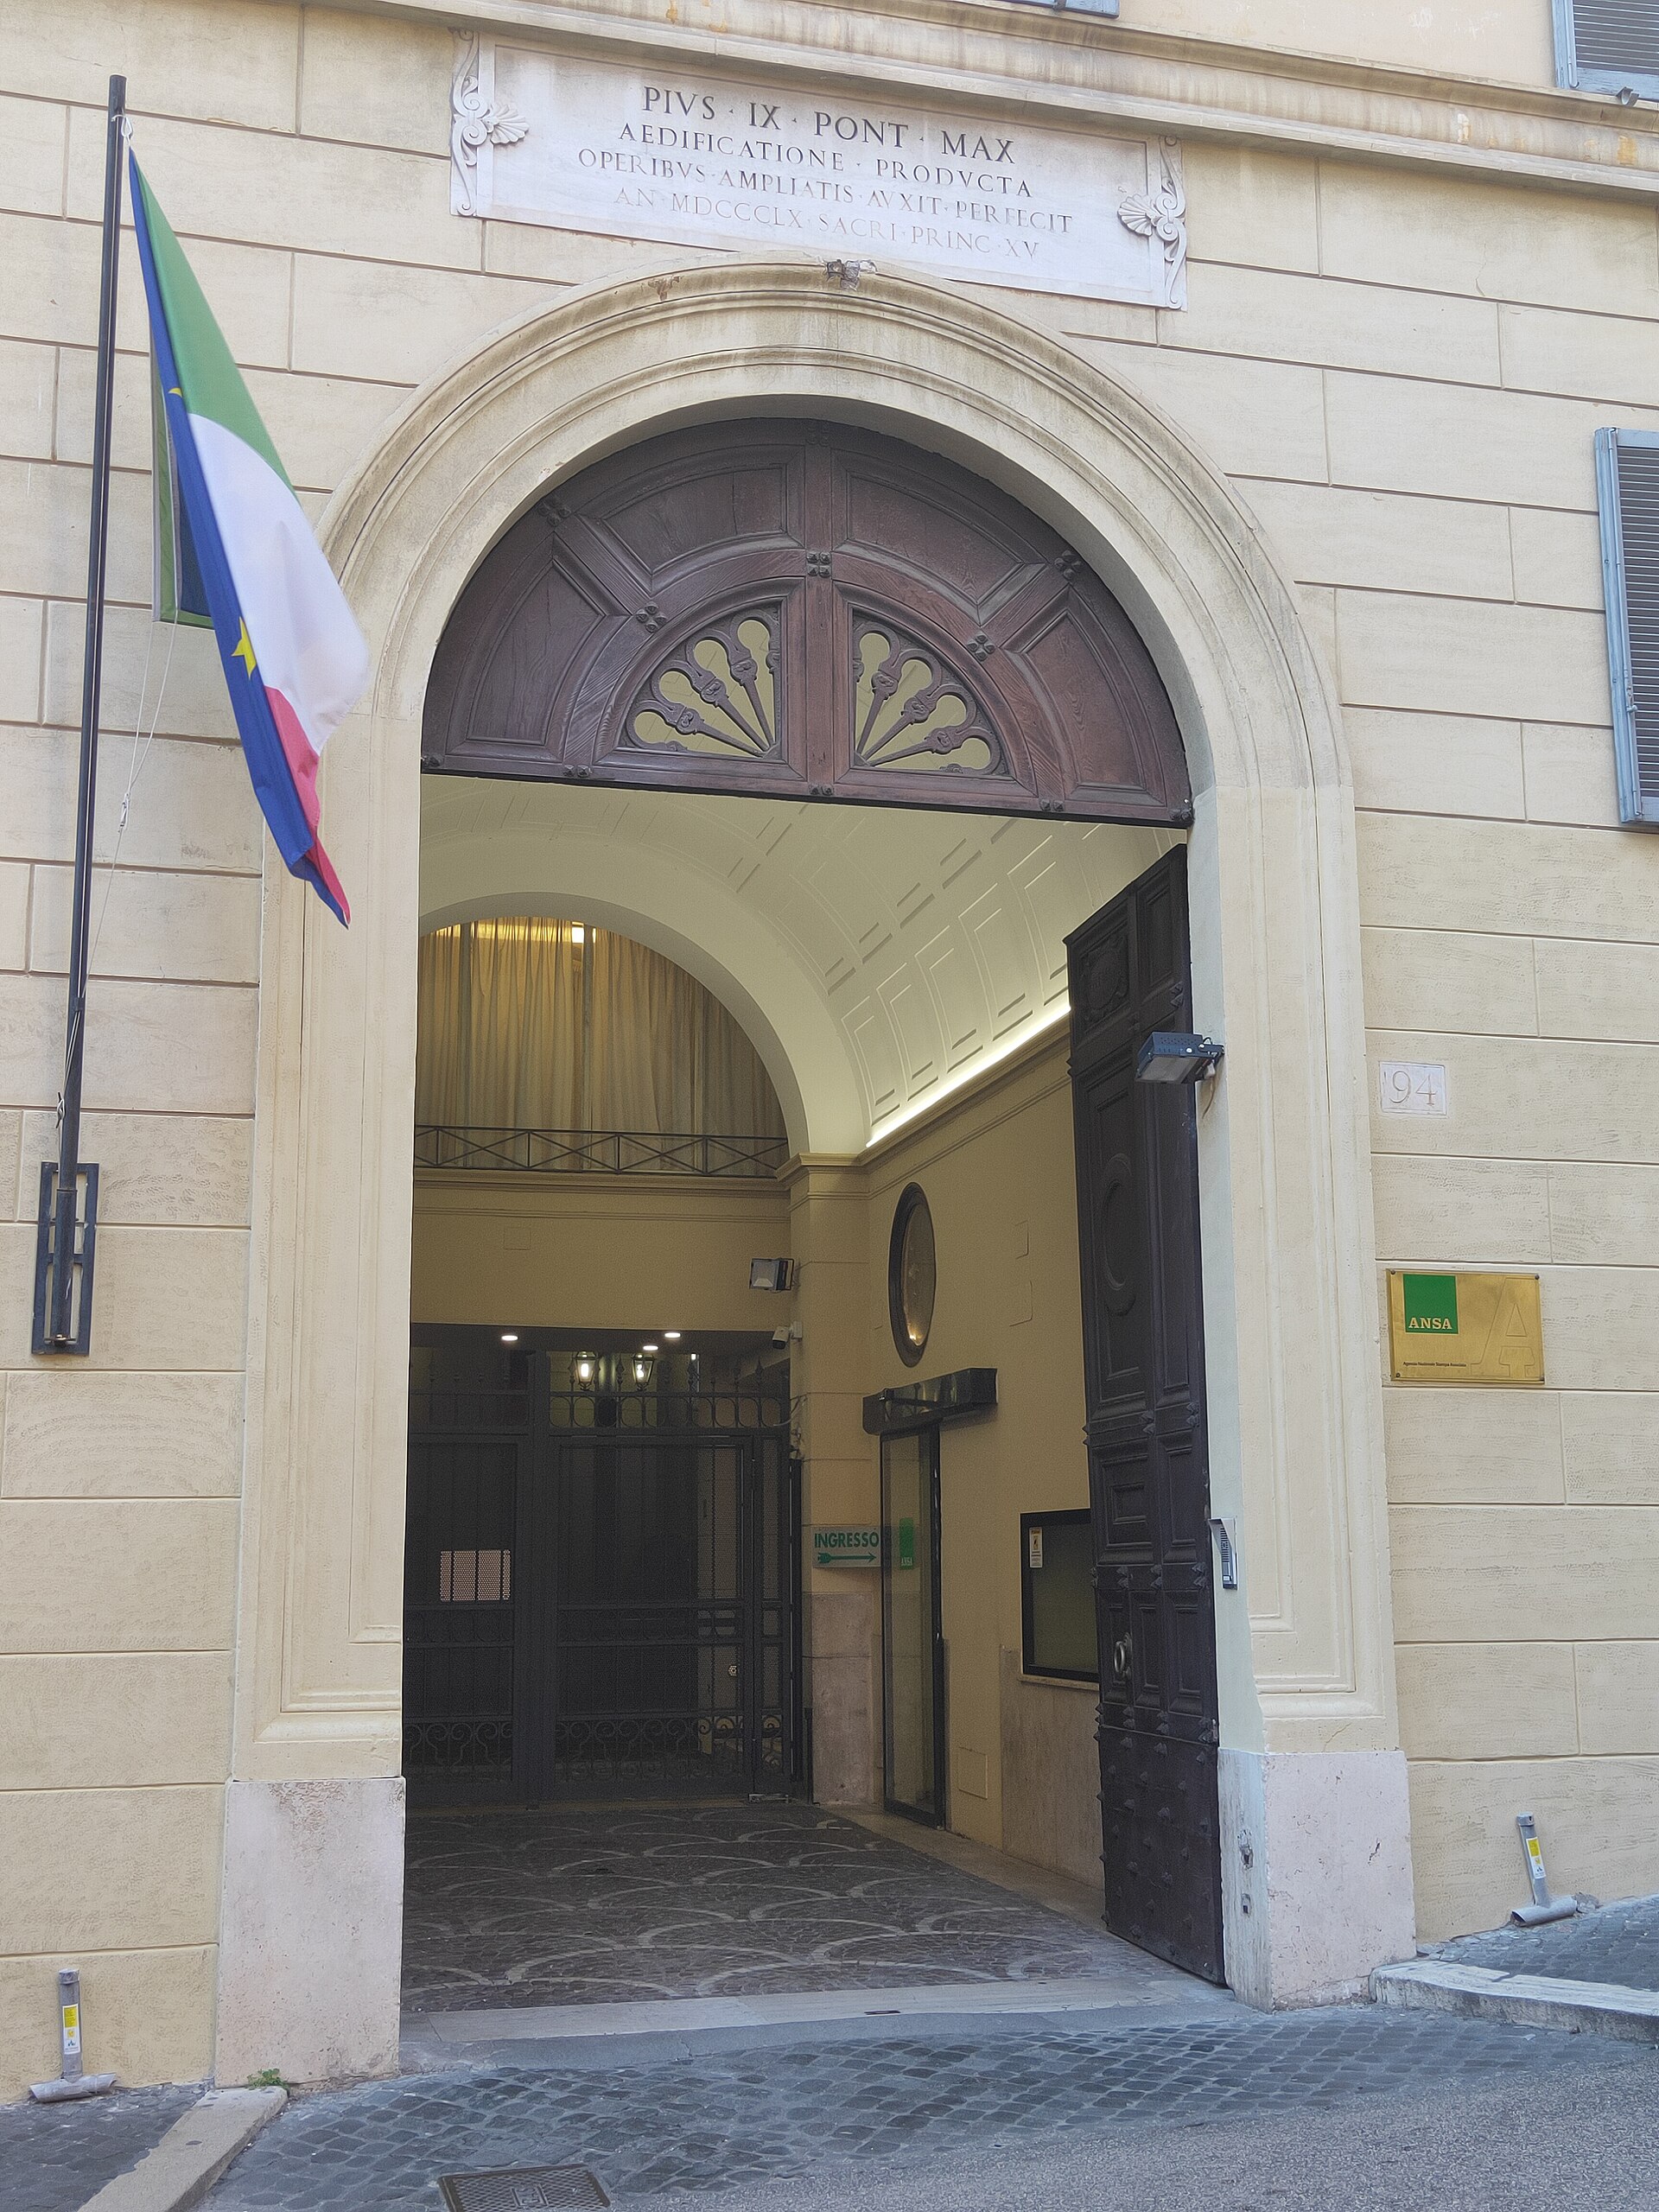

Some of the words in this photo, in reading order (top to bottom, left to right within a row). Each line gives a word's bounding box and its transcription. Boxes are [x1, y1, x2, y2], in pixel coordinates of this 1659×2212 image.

[619, 123, 844, 172] AEDIFICATIONE
[876, 158, 1033, 198] PRODVCTA
[642, 86, 715, 120] PIVS
[748, 102, 782, 130] IX
[814, 111, 909, 149] PONT
[941, 130, 1015, 164] MAX
[578, 148, 706, 182] OPERIBVS
[718, 169, 854, 203] AMPLIATIS
[868, 190, 942, 215] AVXIT
[956, 200, 1072, 233] PERFECIT
[613, 187, 656, 207] AN
[671, 193, 803, 228] MDCCCLX
[818, 213, 897, 241] SACRI
[912, 226, 990, 253] PRINC
[1005, 238, 1039, 259] XV
[1389, 1070, 1438, 1106] 94
[1408, 1317, 1452, 1330] ANSA
[814, 1531, 880, 1548] INGRESSO
